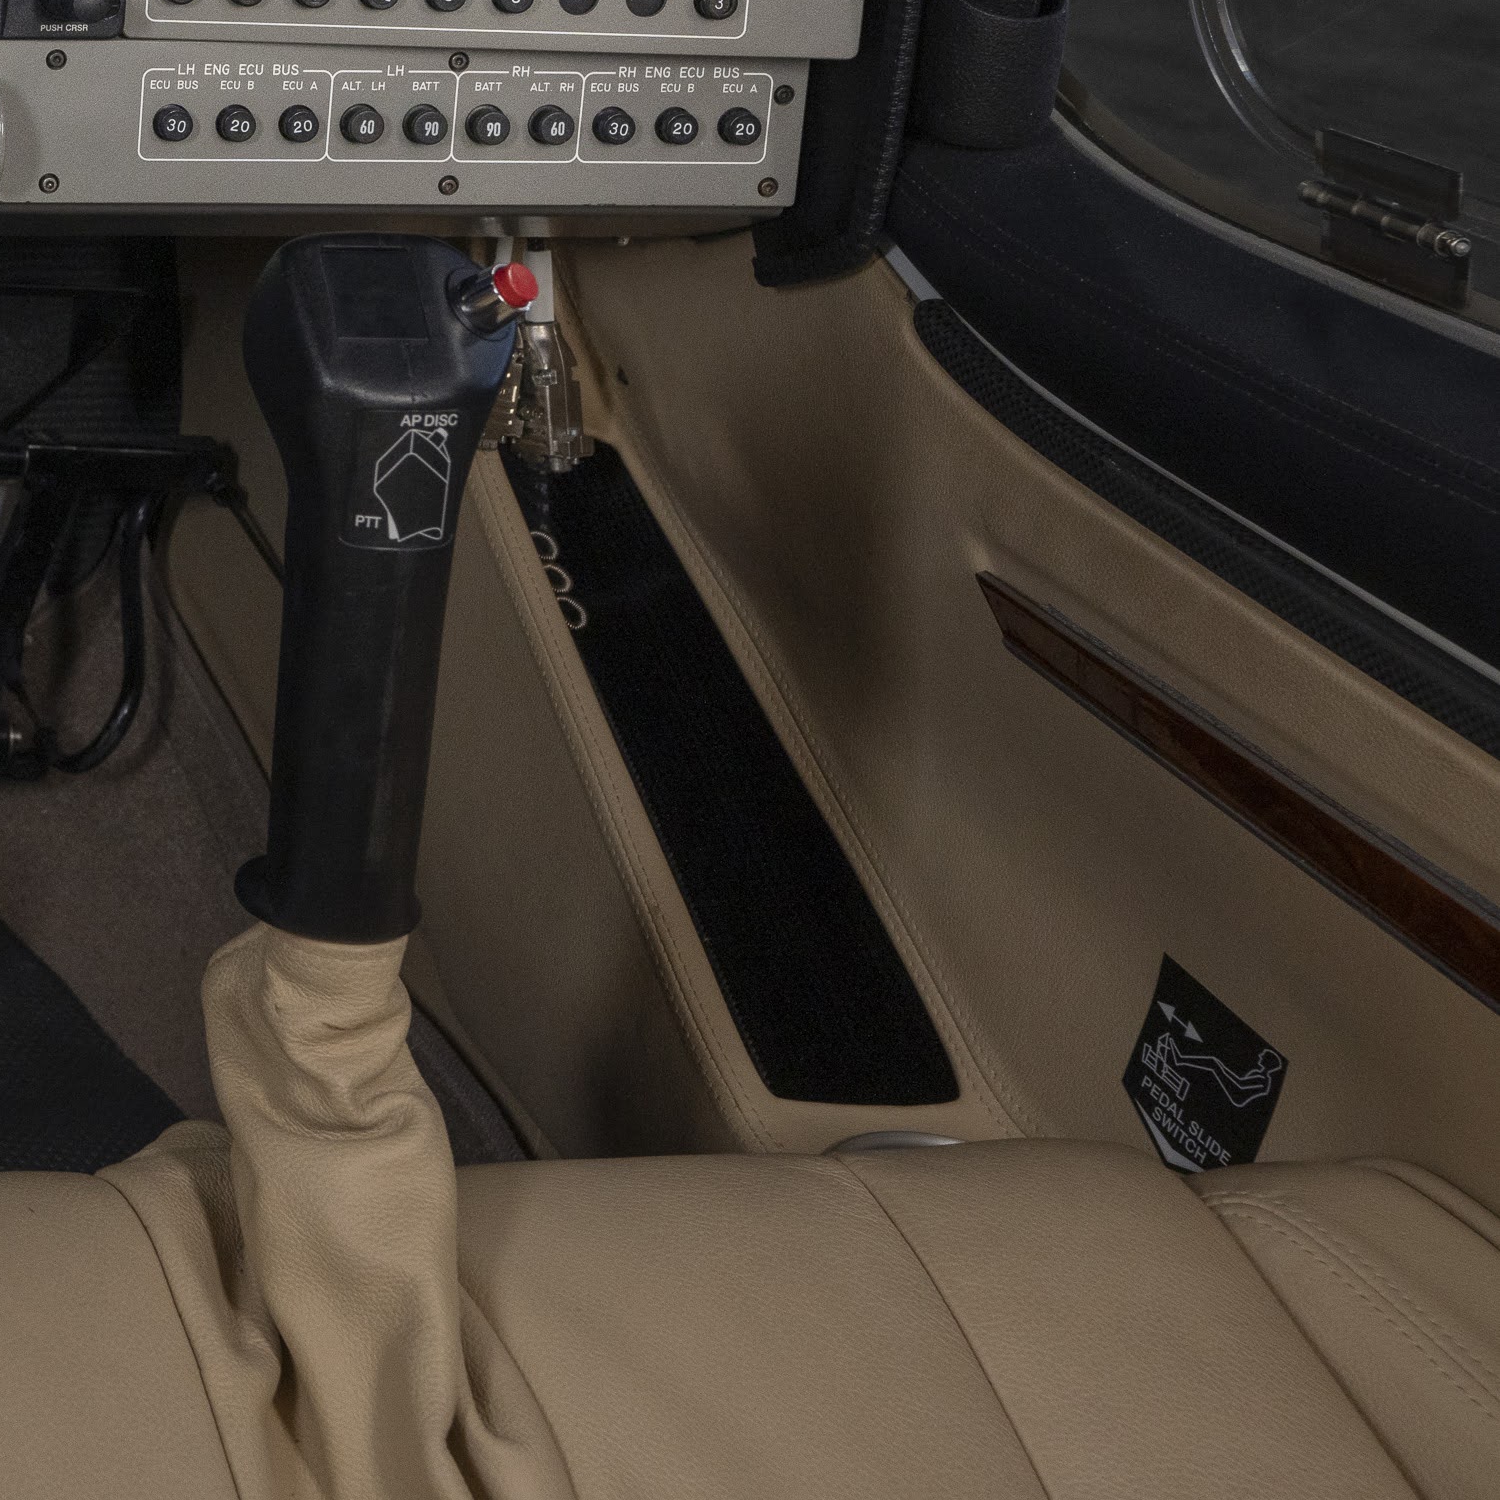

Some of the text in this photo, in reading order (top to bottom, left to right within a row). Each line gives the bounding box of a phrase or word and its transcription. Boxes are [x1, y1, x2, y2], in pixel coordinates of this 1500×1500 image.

[619, 66, 739, 79] RH ENG ECU BUS
[1151, 1107, 1206, 1164] SWITCH
